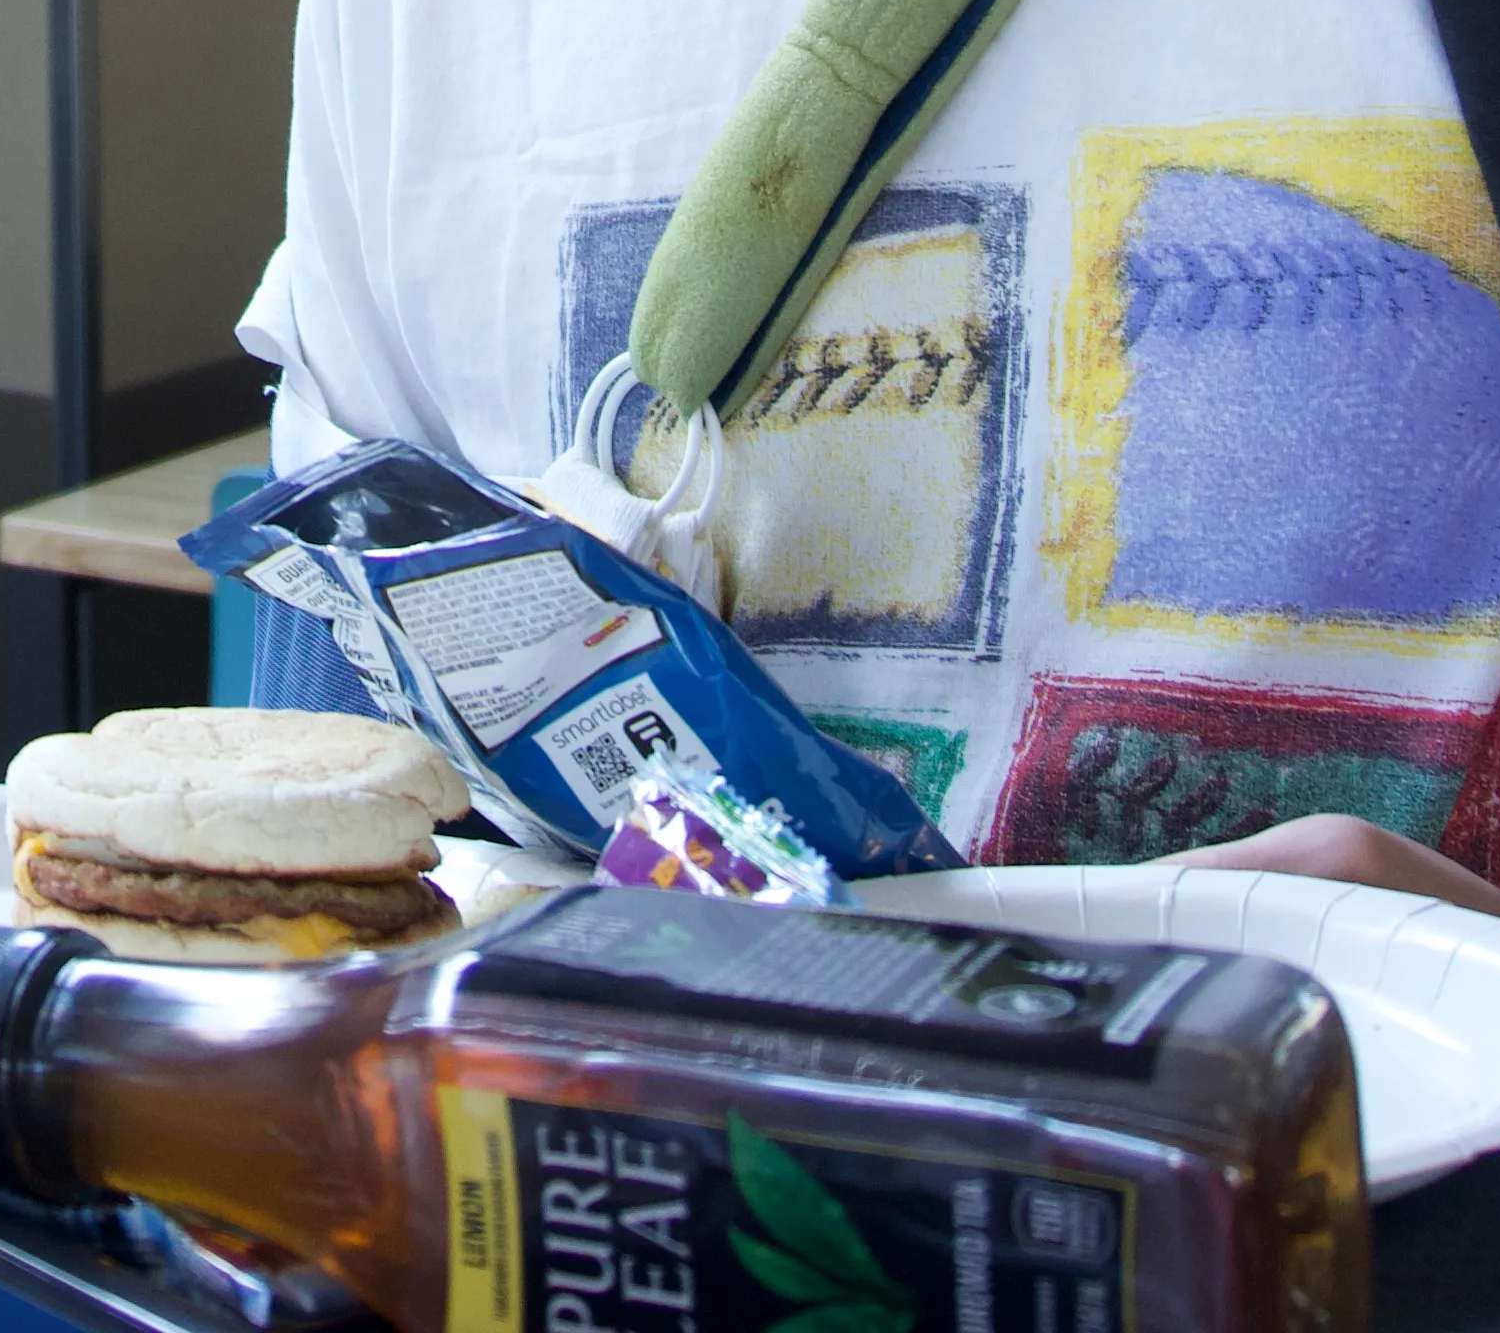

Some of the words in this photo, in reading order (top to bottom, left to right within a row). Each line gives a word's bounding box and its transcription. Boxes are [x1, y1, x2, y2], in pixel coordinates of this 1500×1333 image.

[551, 684, 654, 750] smartlabel
[461, 1180, 487, 1270] LEMON
[536, 1121, 608, 1333] PURE
[612, 1134, 695, 1333] EAF
